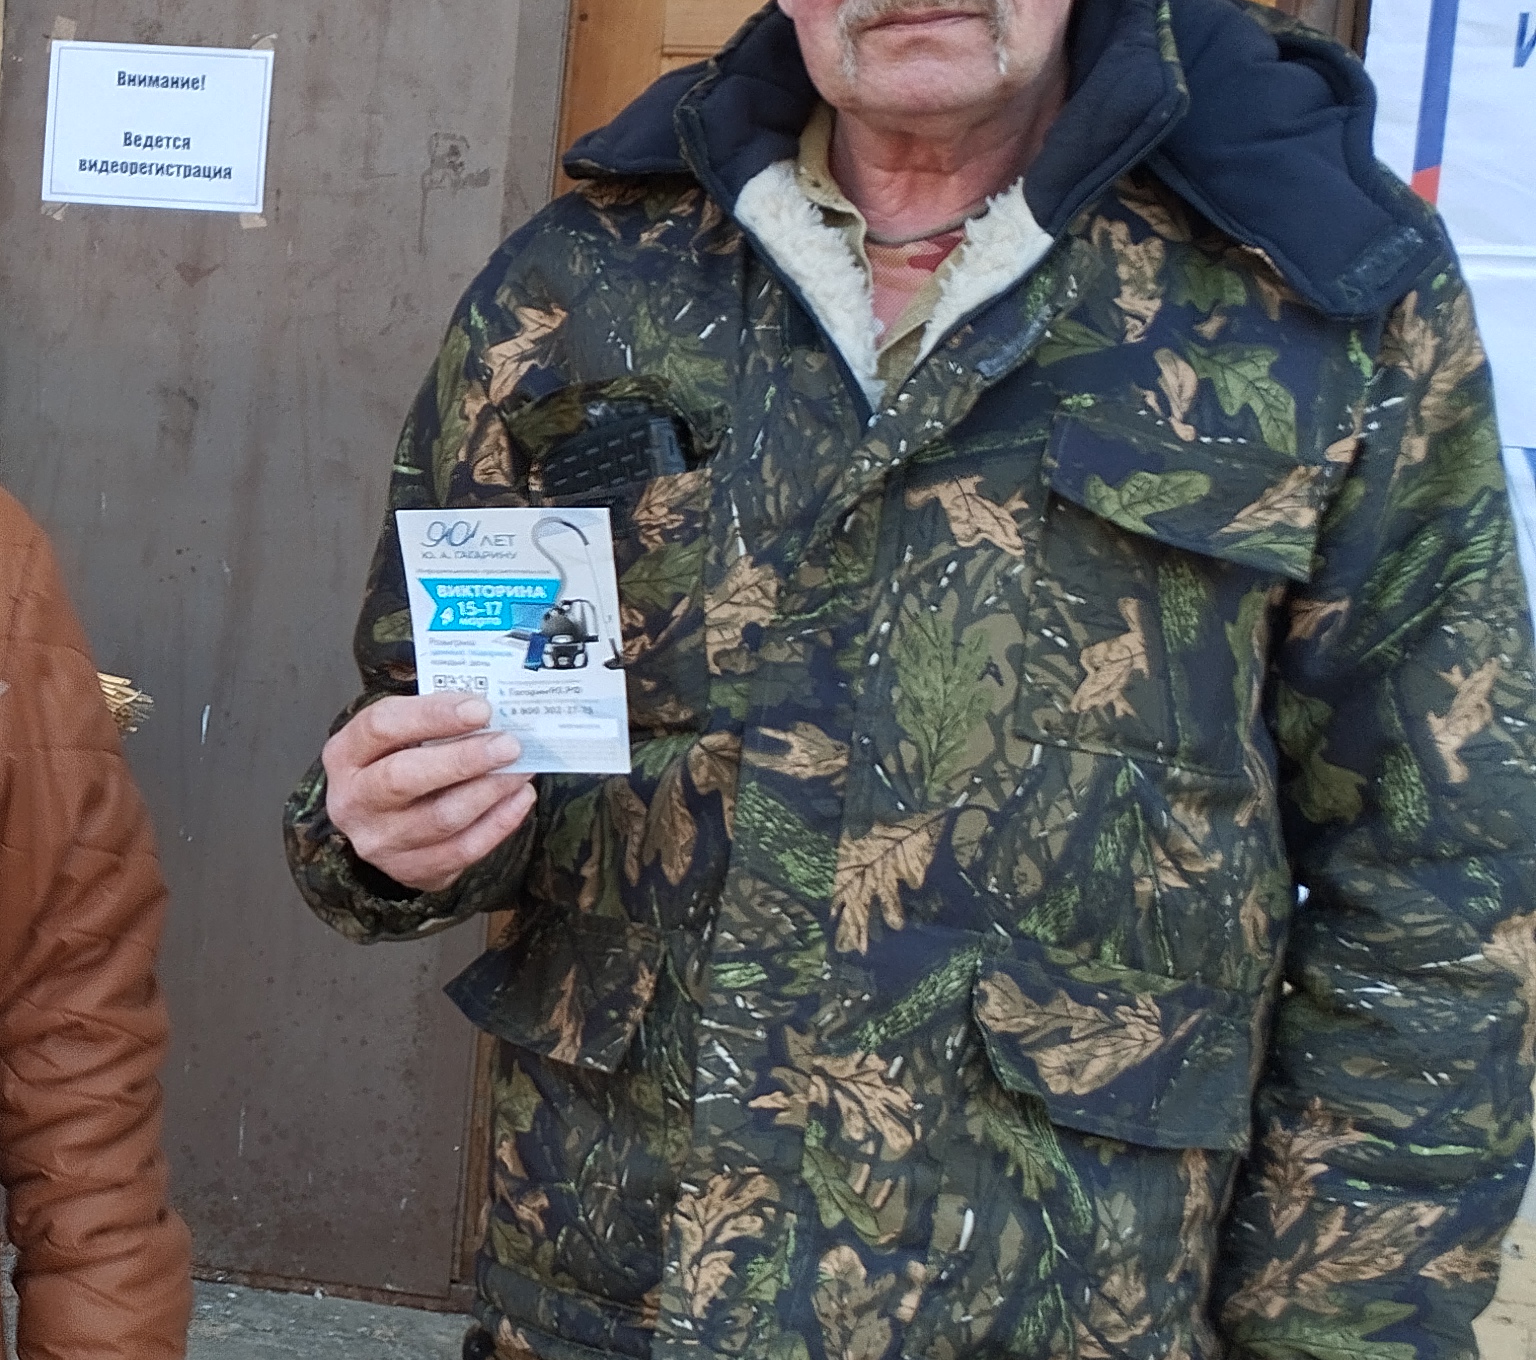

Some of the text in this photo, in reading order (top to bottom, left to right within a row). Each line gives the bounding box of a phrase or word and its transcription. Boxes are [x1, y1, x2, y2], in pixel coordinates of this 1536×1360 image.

[116, 70, 206, 90] Внимание!
[122, 131, 191, 150] Ведется
[78, 158, 233, 181] видеорегистрация
[435, 584, 548, 599] ВИКТОРИНА
